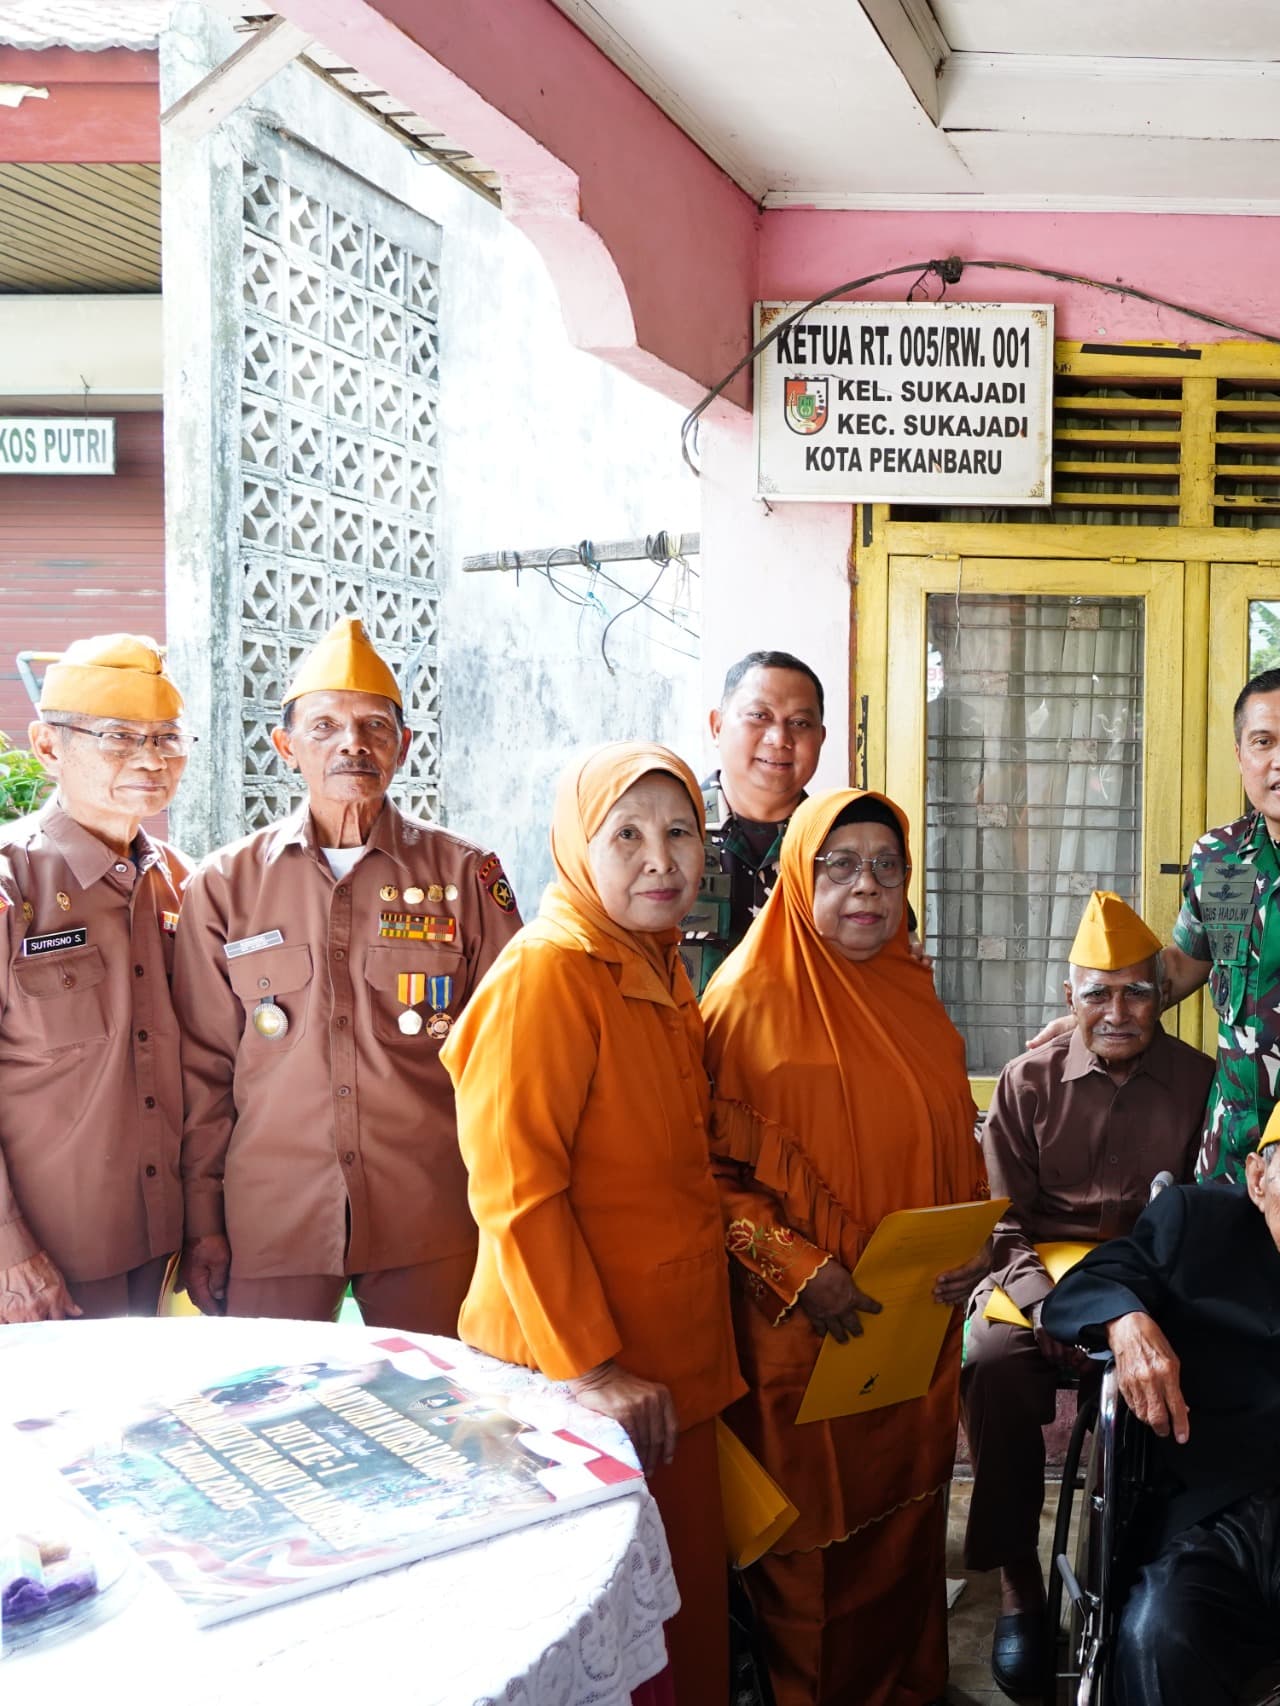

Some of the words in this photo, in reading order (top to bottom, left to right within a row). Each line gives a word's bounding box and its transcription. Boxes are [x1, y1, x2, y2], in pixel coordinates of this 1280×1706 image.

[777, 324, 853, 365] KETUA
[860, 326, 892, 366] RT.
[899, 326, 986, 368] 005/RW.
[993, 327, 1030, 368] 001
[838, 380, 892, 402] KEL.
[901, 381, 1026, 404] SUKAJADI
[837, 413, 895, 435] KEC.
[903, 415, 1028, 438] SUKAJADI
[44, 428, 107, 464] PUTRI
[805, 446, 863, 472] KOTA
[870, 447, 1002, 475] PEKANBARU
[31, 936, 72, 951] SUTRISNO
[74, 934, 82, 943] S.
[306, 1380, 404, 1431] ANTUAN
[260, 1420, 325, 1452] HUT
[155, 1439, 231, 1483] TAHUN
